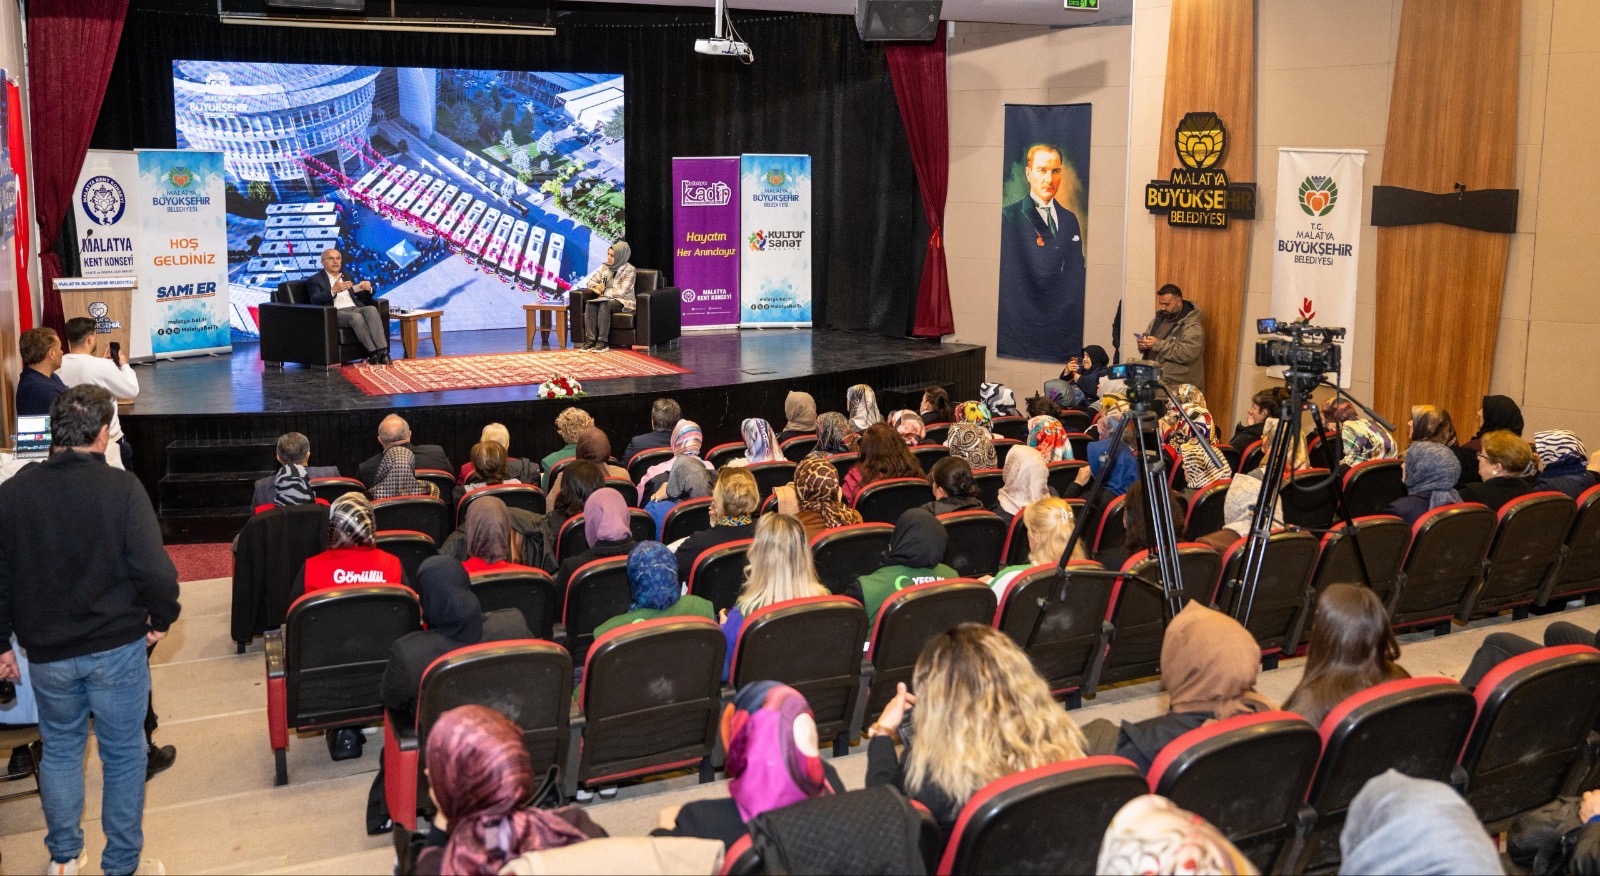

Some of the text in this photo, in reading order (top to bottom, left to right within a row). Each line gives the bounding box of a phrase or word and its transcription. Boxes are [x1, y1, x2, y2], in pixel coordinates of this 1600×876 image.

[1172, 173, 1226, 186] MALATYA
[1171, 210, 1225, 225] BELEDİYESİ
[1311, 223, 1324, 231] T.C.
[686, 232, 727, 244] Hayatın
[1296, 231, 1334, 240] MALATYA
[82, 238, 133, 252] MALATYA
[170, 239, 199, 251] HOŞ
[154, 252, 216, 266] GELDİNİZ
[677, 248, 736, 258] Her Anındayız
[84, 254, 134, 267] KENT KONSEYİ
[1294, 255, 1333, 266] BELEDİYESİ
[197, 282, 216, 294] ER
[333, 568, 387, 584] Gönüllü
